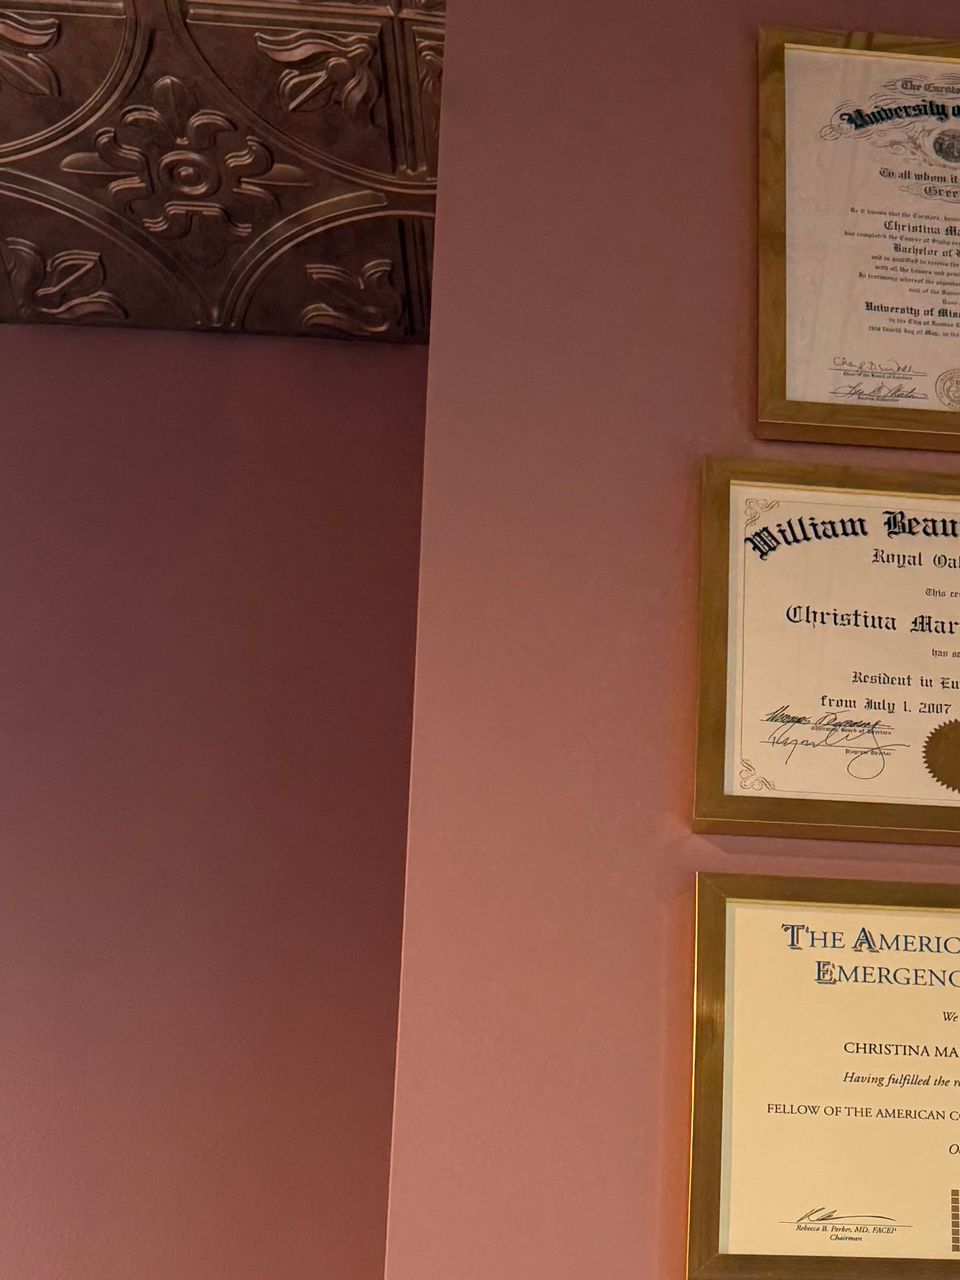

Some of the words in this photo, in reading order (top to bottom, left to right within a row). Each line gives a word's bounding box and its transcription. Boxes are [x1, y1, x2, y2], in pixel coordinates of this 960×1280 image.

[839, 99, 948, 131] University
[884, 219, 942, 237] Christina
[942, 246, 953, 259] of
[865, 301, 921, 318] University
[923, 306, 936, 318] of
[745, 516, 868, 561] William
[872, 548, 923, 569] Royal
[925, 588, 946, 598] This
[786, 605, 897, 631] Christina
[852, 671, 912, 687] Resident
[920, 676, 933, 688] in
[820, 695, 857, 709] from
[864, 697, 896, 714] July
[918, 702, 952, 716] 2007
[780, 923, 845, 951] THE
[942, 1011, 959, 1023] We
[843, 1041, 930, 1057] CHRISTINA
[844, 1071, 884, 1087] Having
[886, 1073, 931, 1088] fulfilled
[933, 1076, 952, 1087] the
[767, 1103, 820, 1116] FELLOW
[823, 1105, 842, 1117] OF
[844, 1106, 873, 1118] THE
[876, 1108, 946, 1121] AMERICAN
